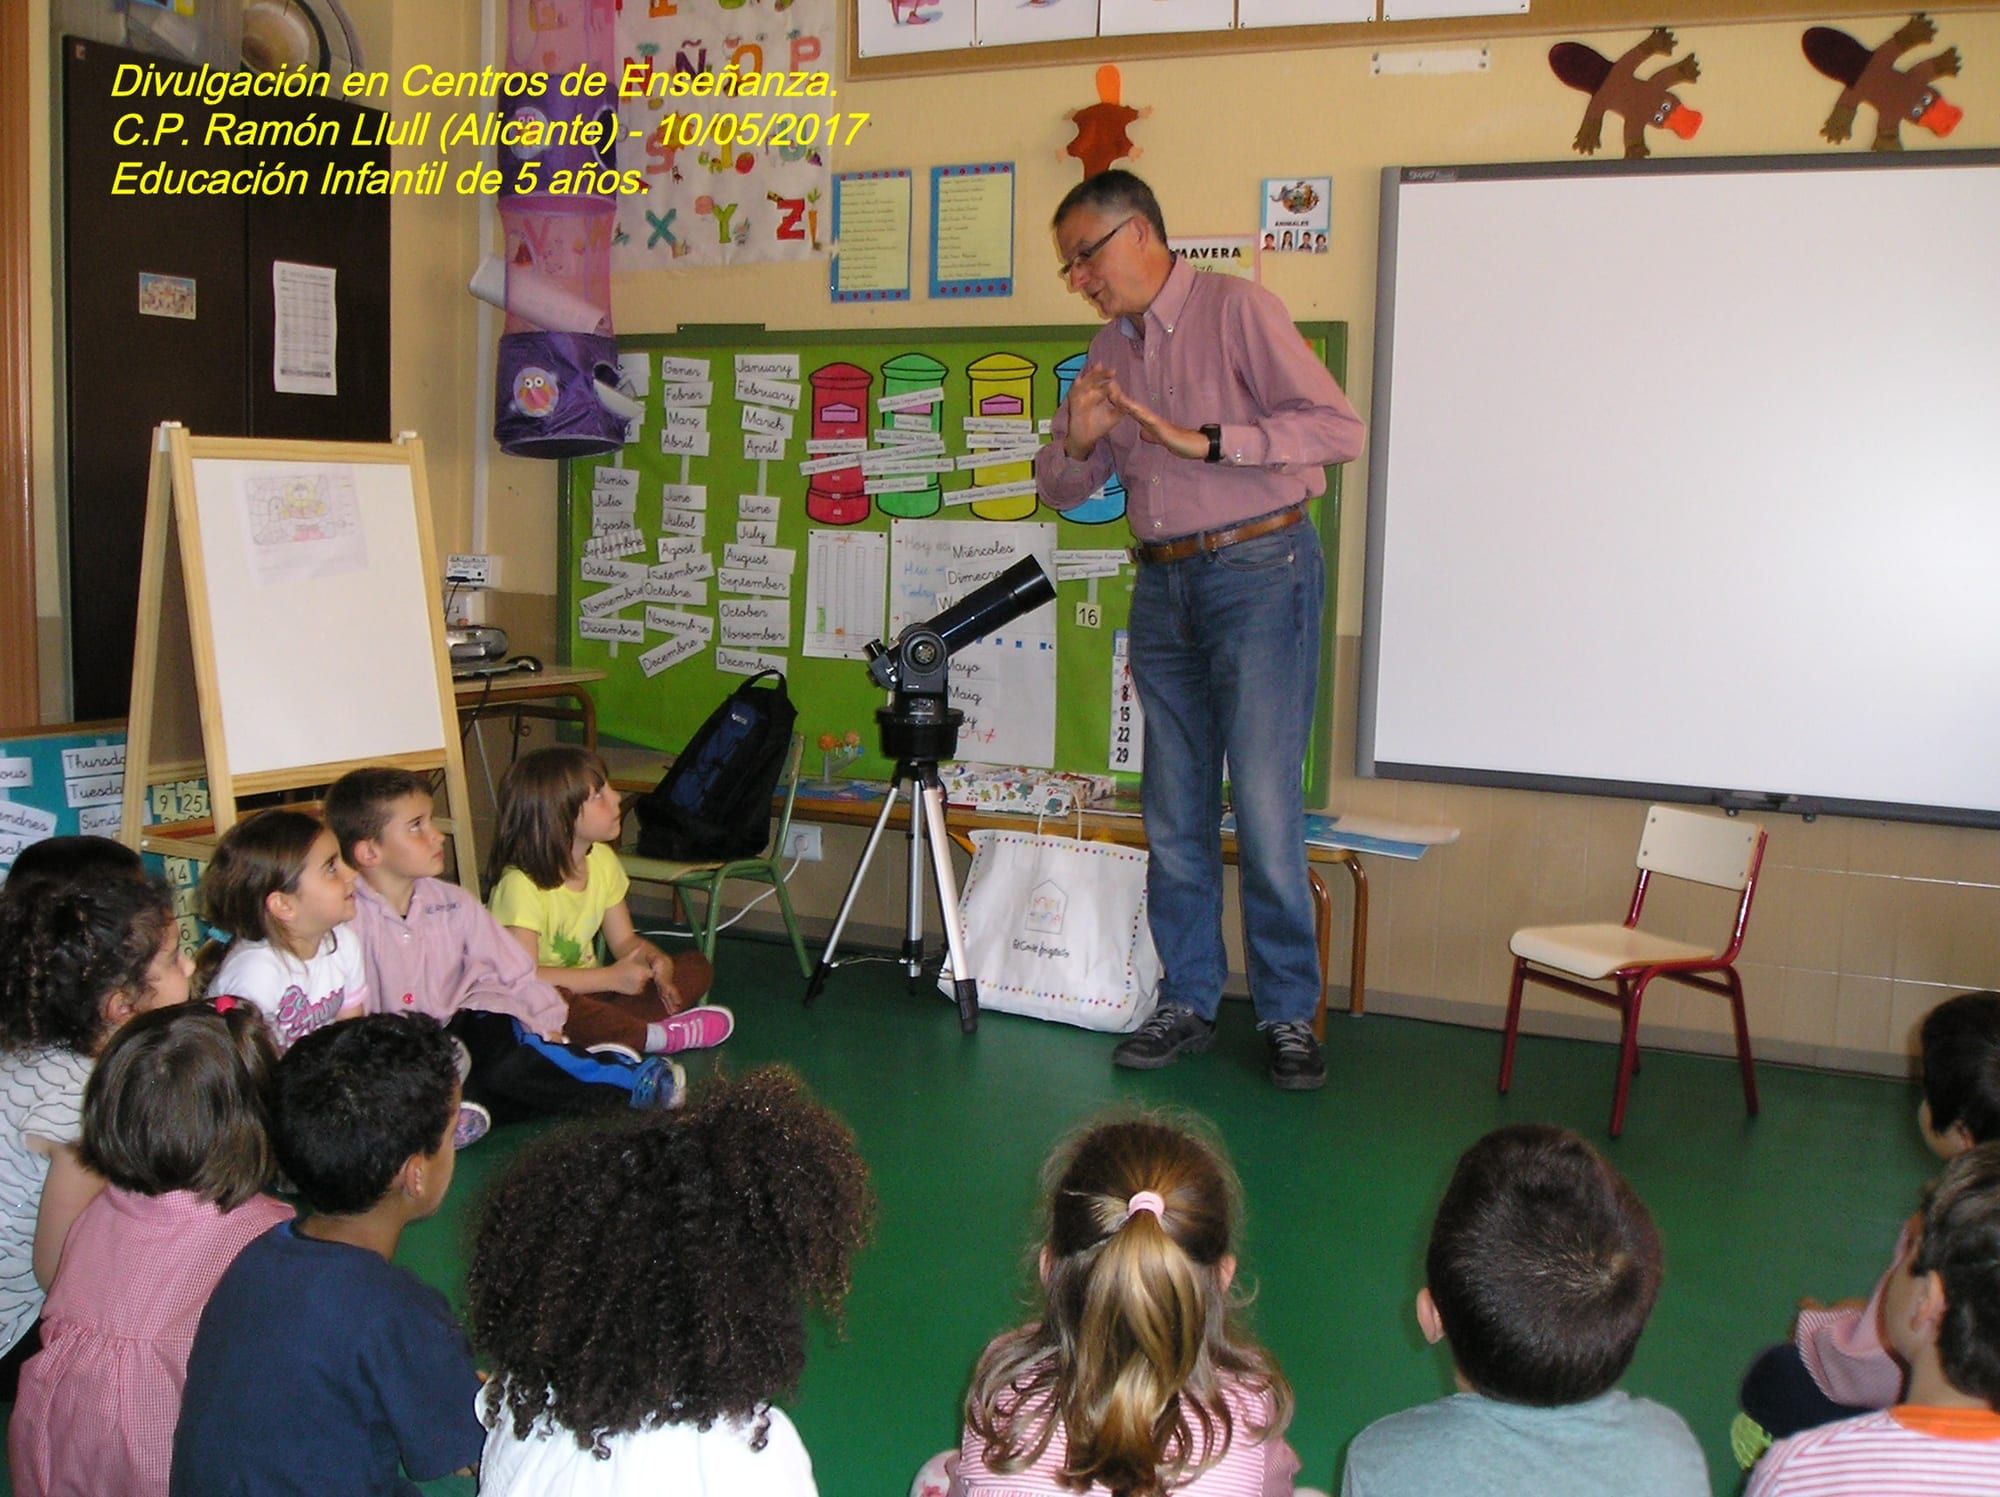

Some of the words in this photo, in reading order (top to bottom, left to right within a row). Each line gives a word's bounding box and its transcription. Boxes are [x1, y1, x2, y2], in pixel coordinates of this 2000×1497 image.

[1169, 247, 1242, 260] MAVERA
[736, 359, 793, 378] January
[737, 380, 796, 408] February
[744, 409, 785, 431] March
[663, 434, 695, 449] Abril
[746, 440, 778, 458] April
[596, 471, 630, 487] Junio
[739, 500, 773, 515] June
[594, 517, 631, 536] Agosto
[737, 525, 768, 545] July
[661, 542, 697, 561] Agost
[726, 549, 769, 569] August
[952, 541, 1015, 559] Miércoles
[582, 562, 630, 579] Octubre
[643, 582, 692, 599] Octubre
[720, 571, 788, 593] September
[720, 603, 769, 619] October
[1079, 607, 1098, 627] 16
[722, 626, 787, 642] November
[1117, 726, 1131, 743] 22
[65, 750, 126, 769] Thursda
[1115, 747, 1129, 764] 29
[0, 770, 27, 780] ous
[68, 780, 124, 799] Tuesda
[159, 794, 168, 812] 9
[183, 793, 202, 813] 25
[82, 809, 122, 830] Sunda
